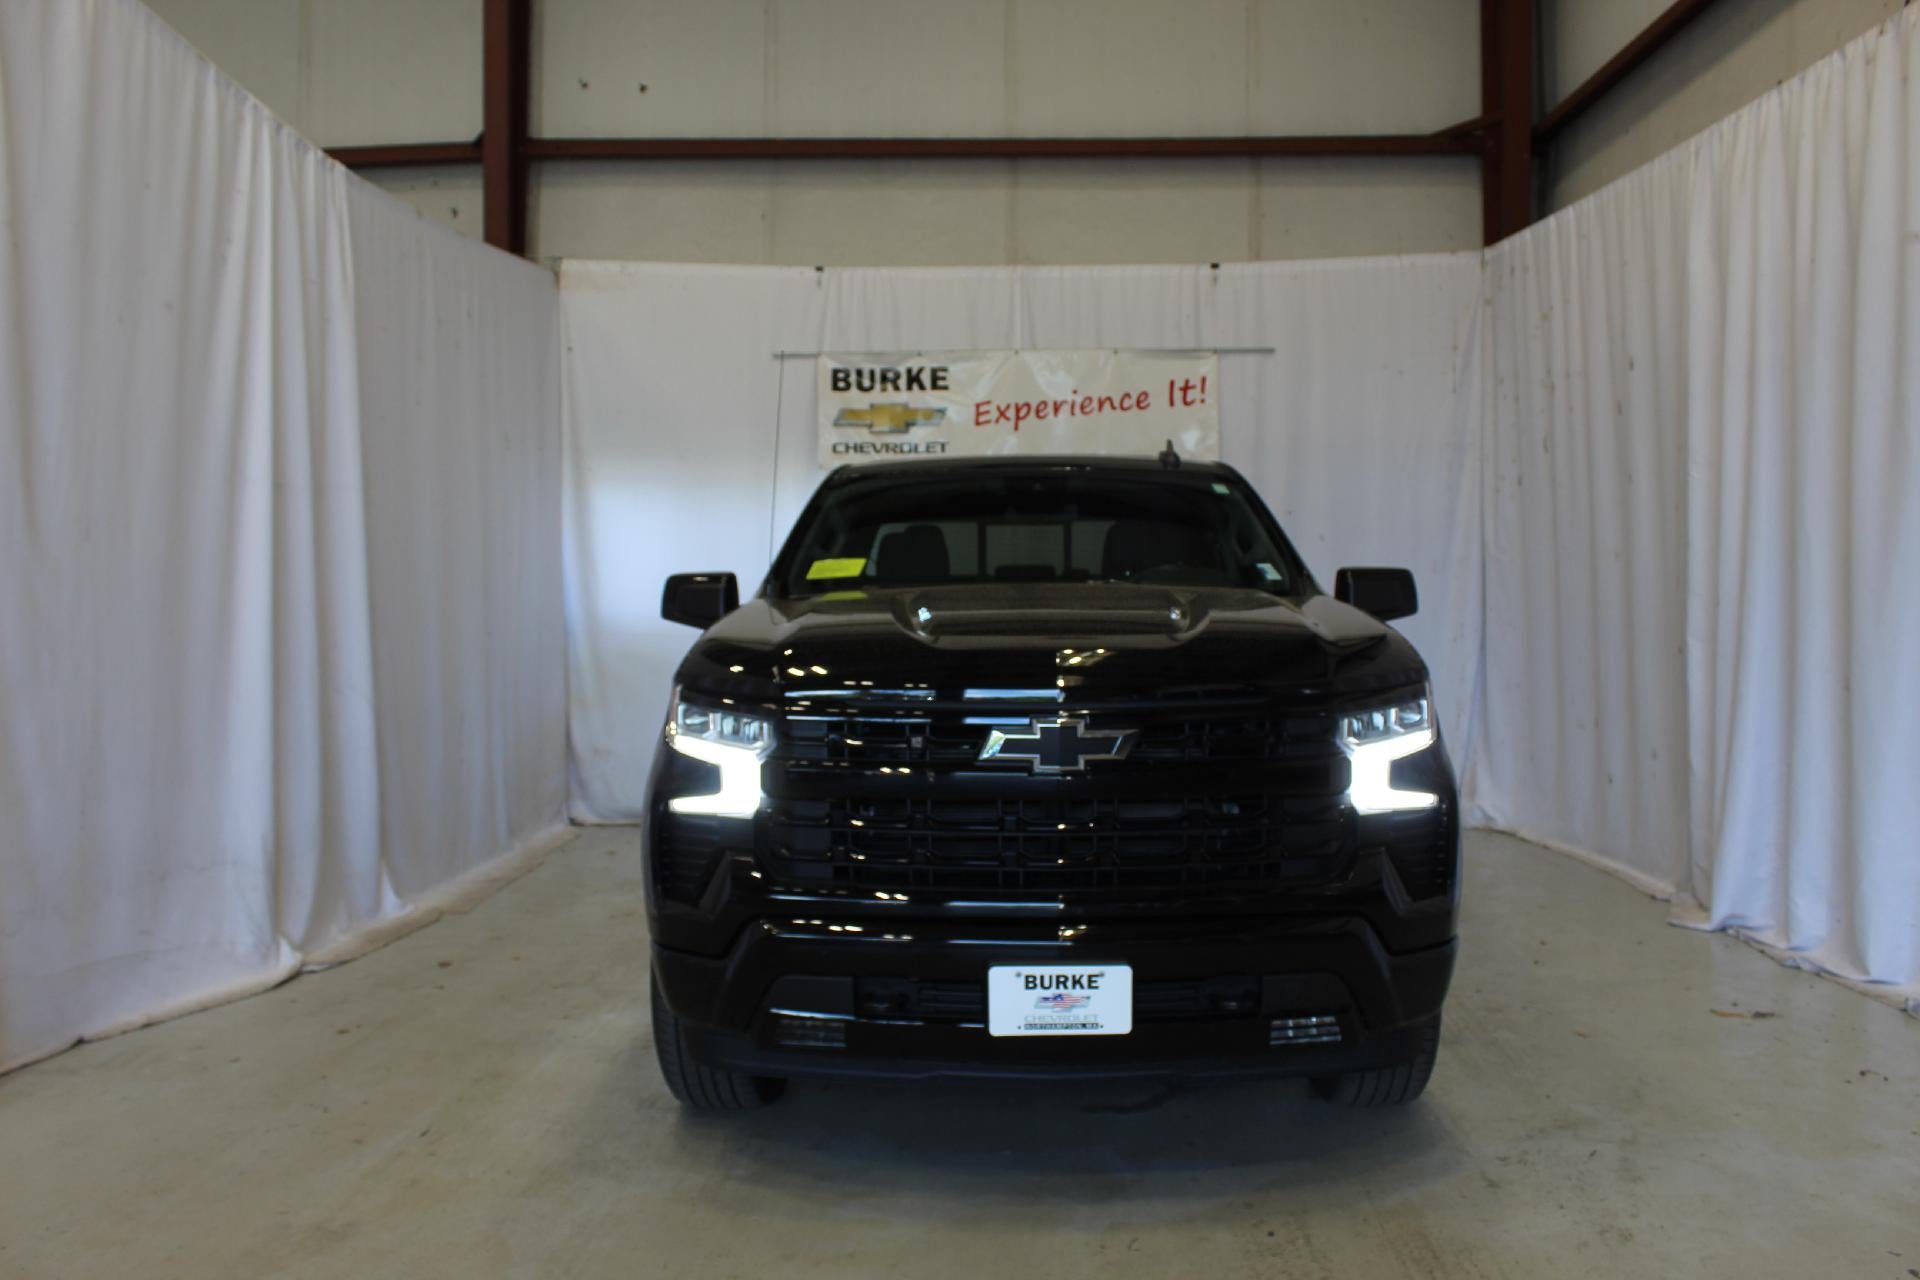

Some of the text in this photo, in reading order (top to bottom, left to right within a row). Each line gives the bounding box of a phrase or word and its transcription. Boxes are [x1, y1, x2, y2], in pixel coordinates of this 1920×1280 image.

[831, 366, 950, 393] BURKE
[974, 375, 1208, 431] Experience It!
[831, 440, 950, 454] CHEVROLET
[1024, 974, 1100, 990] BURKE
